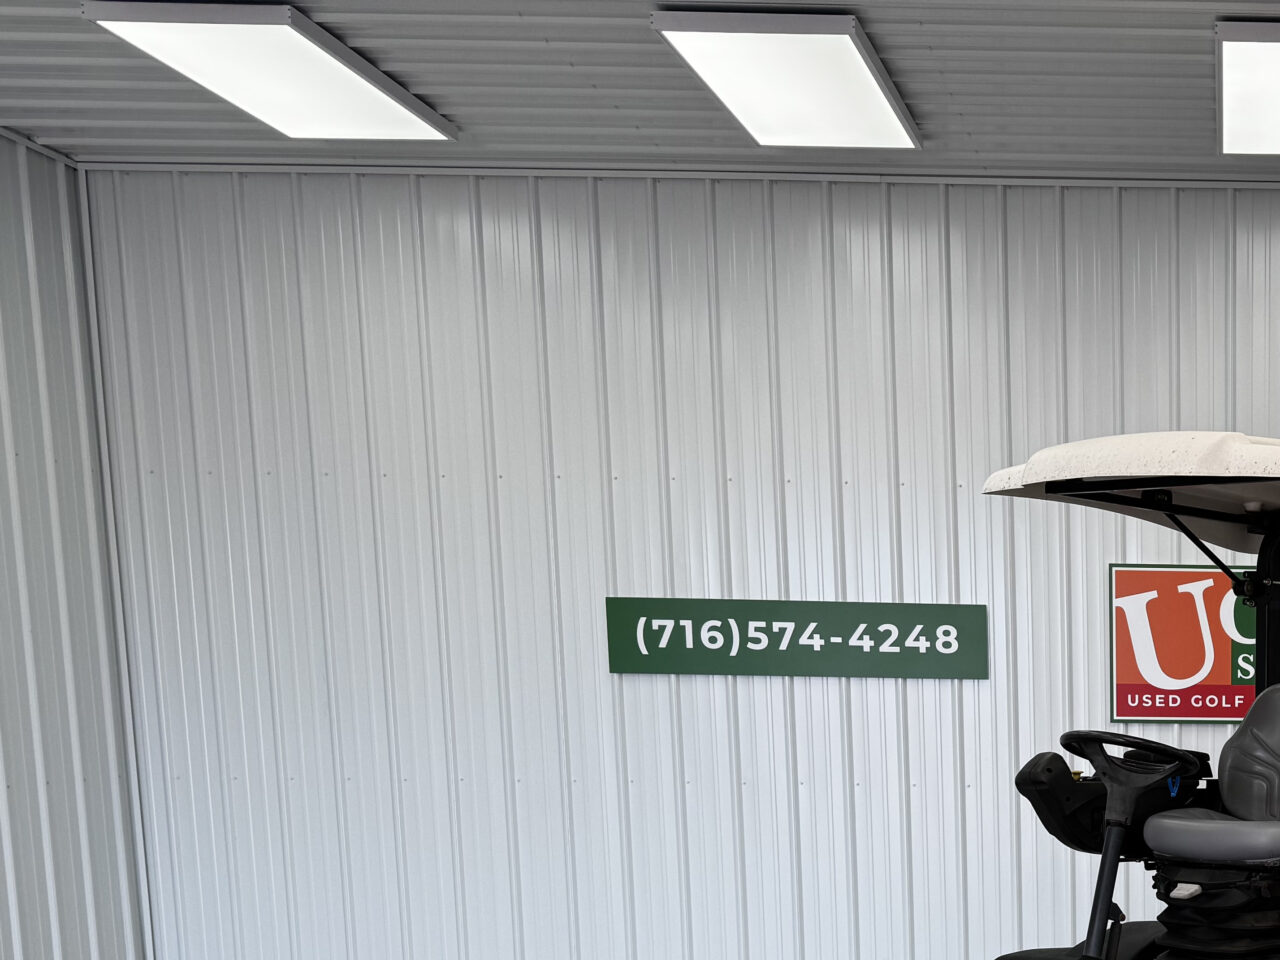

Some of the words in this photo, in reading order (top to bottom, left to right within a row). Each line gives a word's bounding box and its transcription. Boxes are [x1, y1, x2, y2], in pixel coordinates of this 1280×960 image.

[636, 616, 959, 657] (716)574-4248
[1127, 694, 1181, 708] USED
[1190, 695, 1245, 708] GOLF
